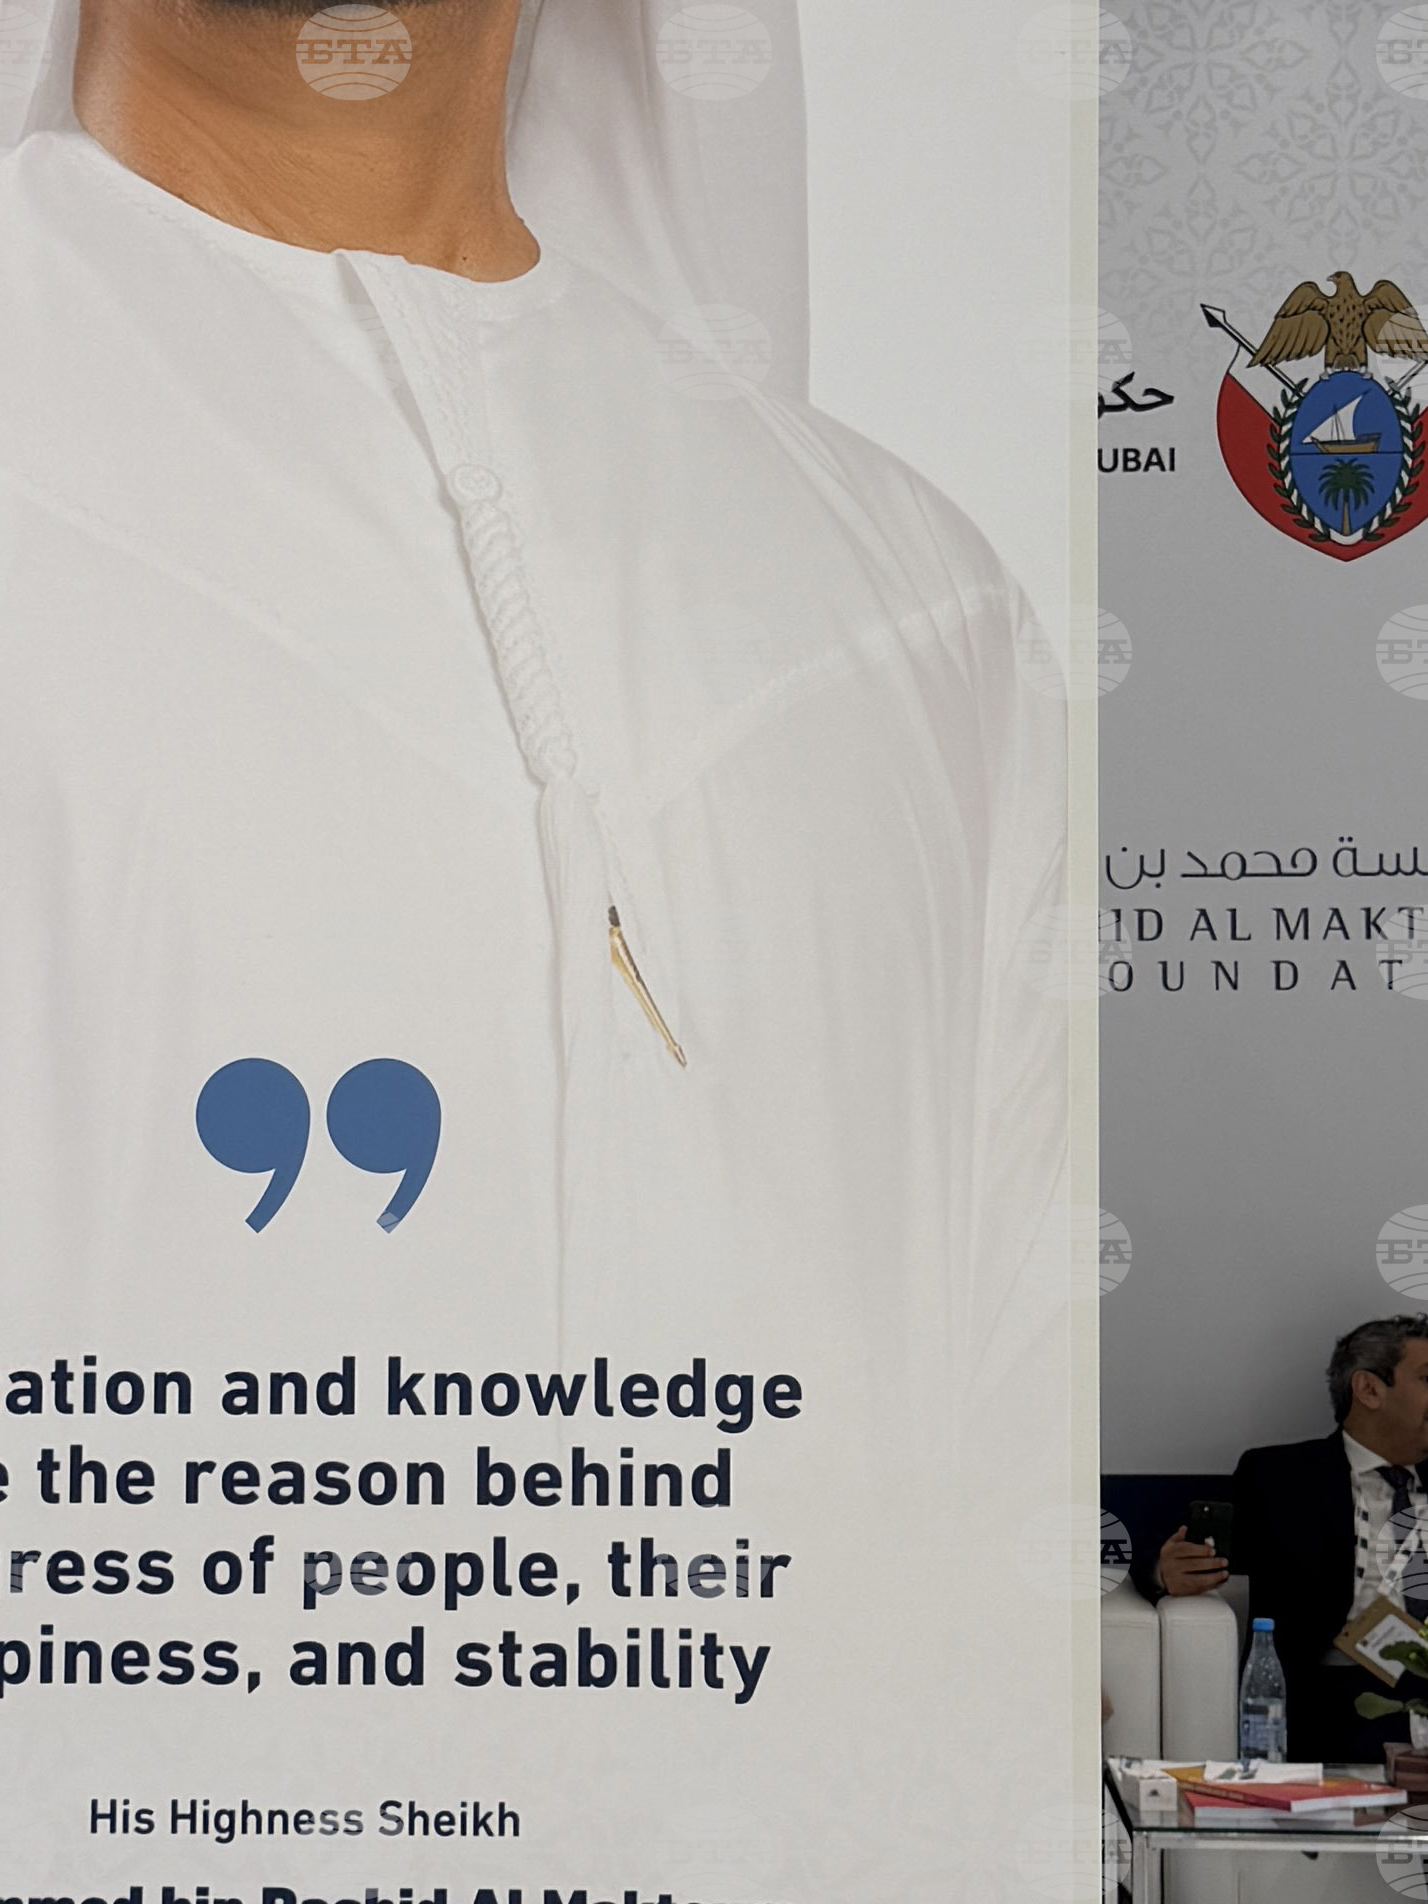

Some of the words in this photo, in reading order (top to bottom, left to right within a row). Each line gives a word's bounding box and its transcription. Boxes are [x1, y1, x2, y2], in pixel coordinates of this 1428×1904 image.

[1098, 447, 1175, 473] UBAI
[1106, 847, 1165, 889] بن
[1181, 848, 1317, 880] محمد
[1098, 907, 1164, 942] ID
[1190, 907, 1252, 942] AL
[222, 1356, 355, 1416] and
[388, 1356, 802, 1433] knowledge
[37, 1445, 154, 1504] the
[186, 1461, 444, 1505] reason
[477, 1446, 730, 1507] behind
[203, 1535, 274, 1595] of
[303, 1536, 579, 1610] people,
[608, 1537, 791, 1598] their
[290, 1626, 424, 1686] and
[455, 1627, 770, 1704] stability
[91, 1799, 154, 1834] His
[171, 1799, 363, 1844] Highness
[379, 1800, 519, 1837] Sheikh
